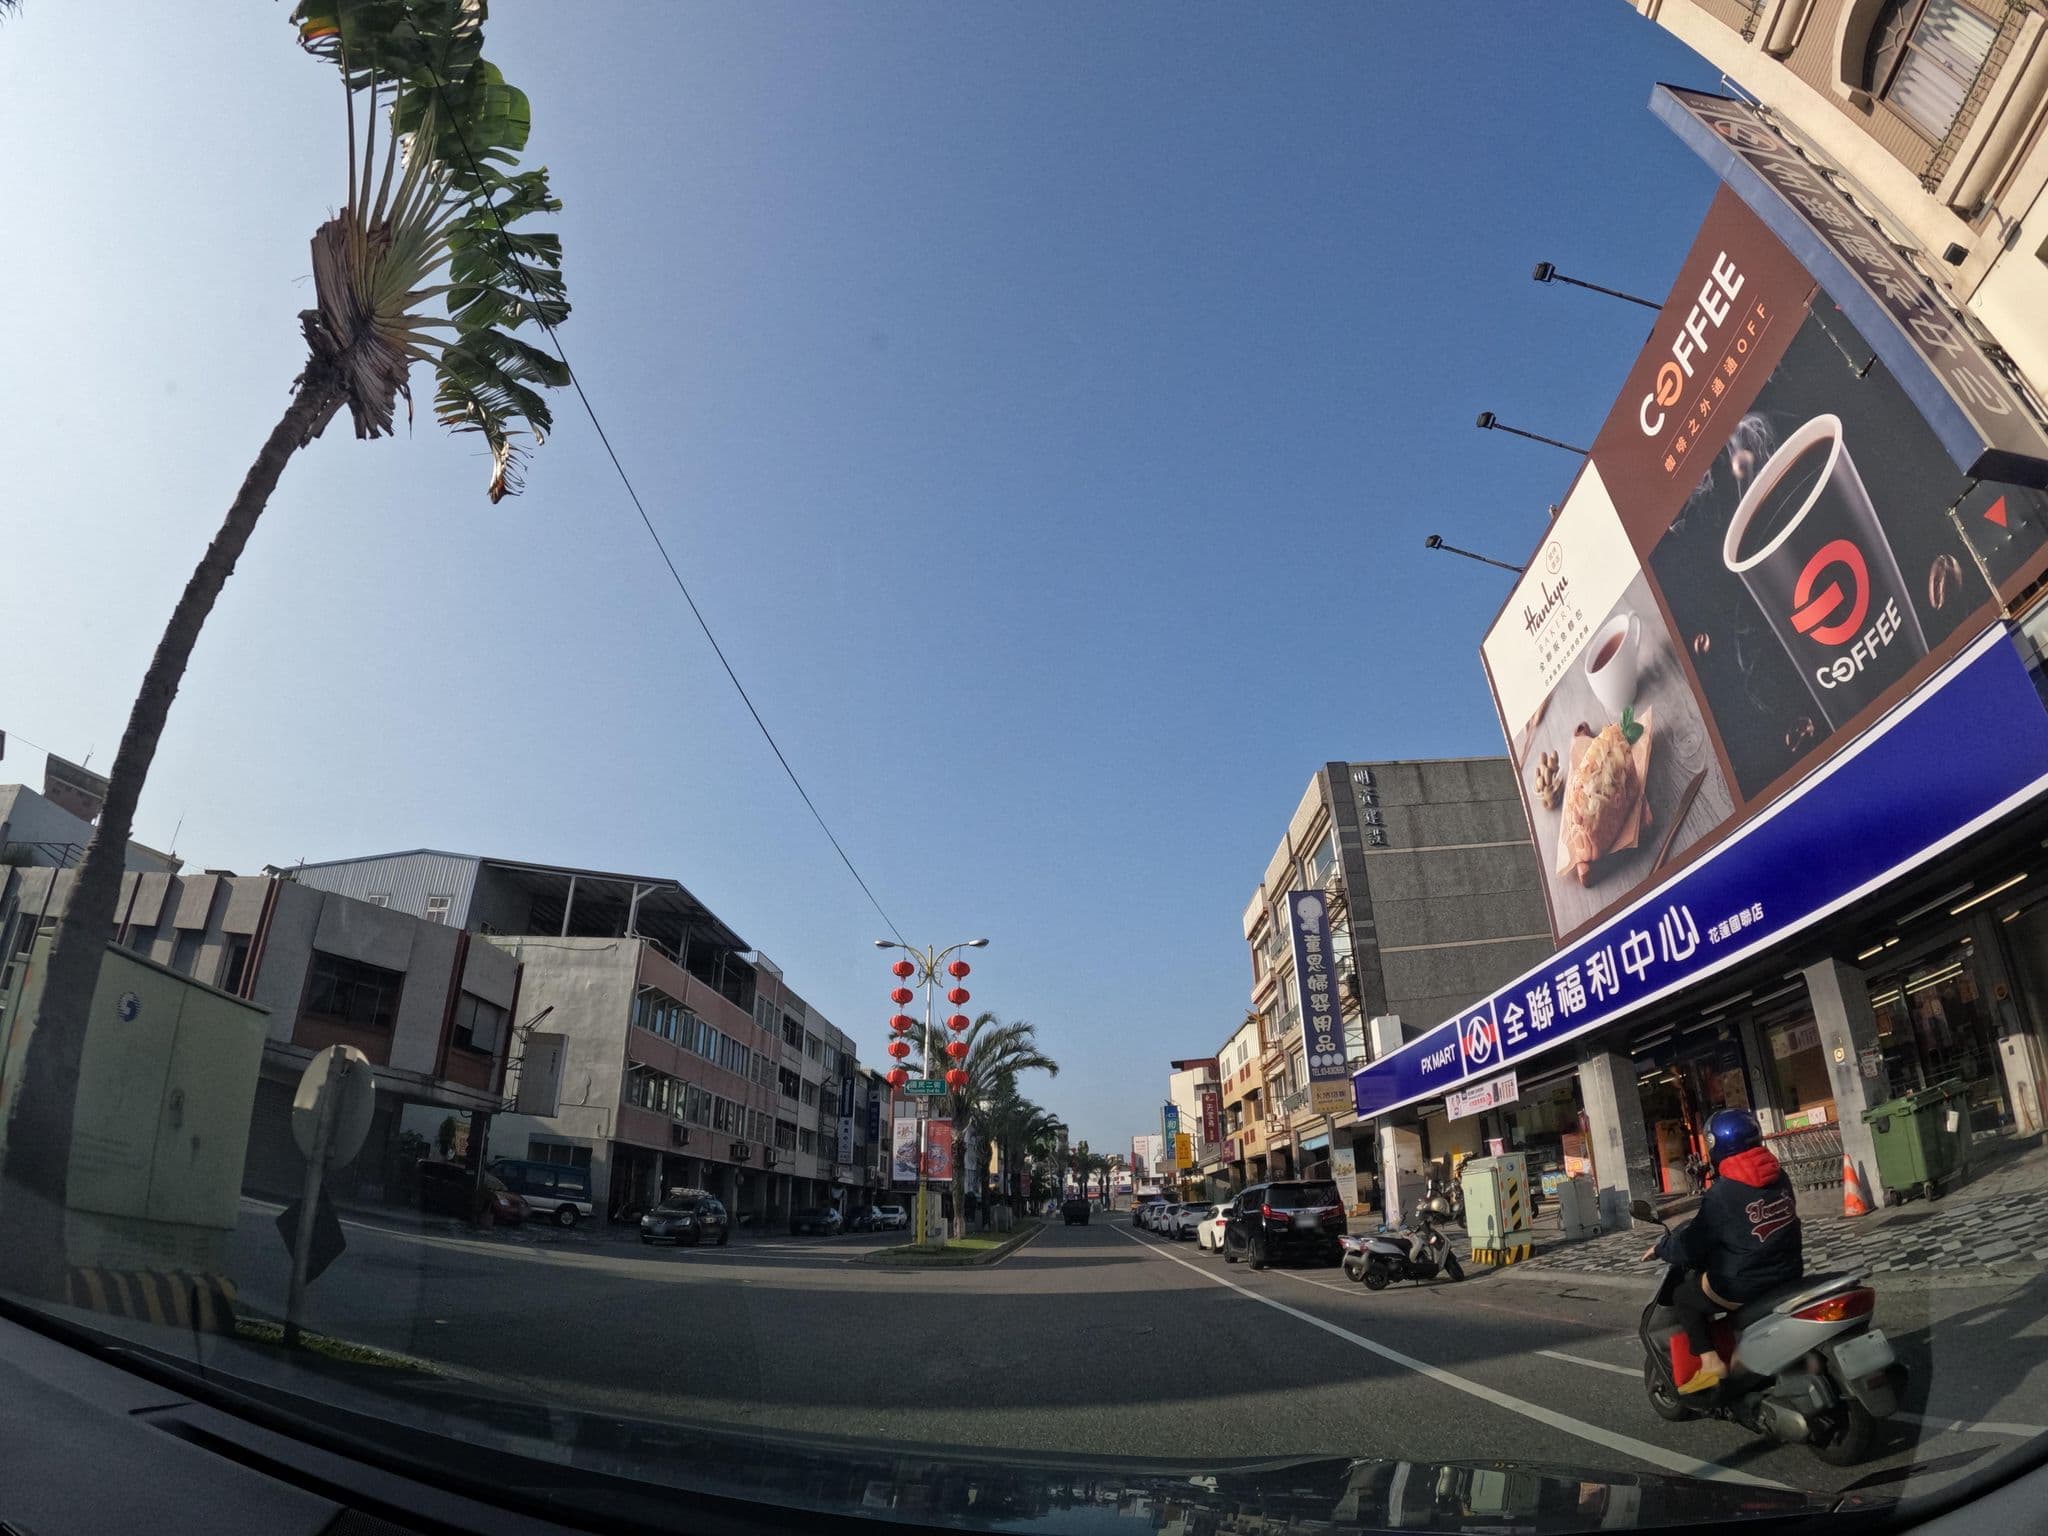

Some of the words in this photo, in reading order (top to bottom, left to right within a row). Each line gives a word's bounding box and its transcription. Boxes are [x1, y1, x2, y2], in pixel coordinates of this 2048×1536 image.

[1762, 162, 2013, 415] 全聯福利中心
[1640, 251, 1745, 436] COFFEE
[1523, 576, 1569, 637] Hankyu
[1816, 596, 1902, 689] COFFEE
[1707, 902, 1764, 945] 花蓮國聯店
[1503, 905, 1700, 1046] 全聯福利中心
[1421, 1055, 1433, 1075] PX
[1432, 1043, 1456, 1070] MART
